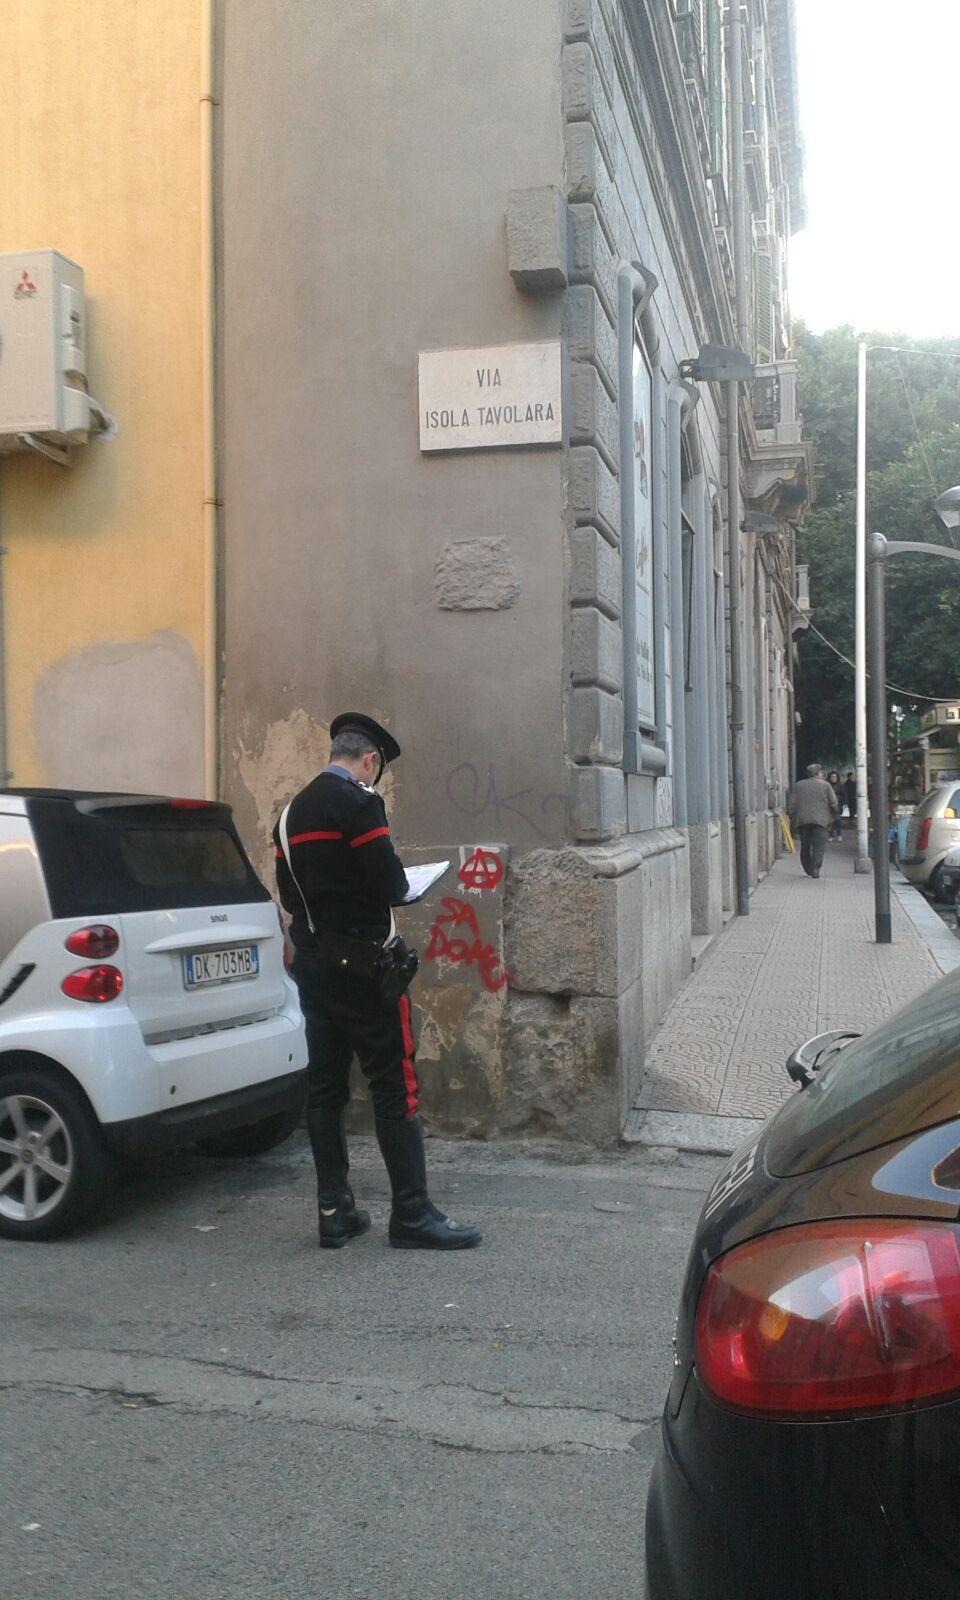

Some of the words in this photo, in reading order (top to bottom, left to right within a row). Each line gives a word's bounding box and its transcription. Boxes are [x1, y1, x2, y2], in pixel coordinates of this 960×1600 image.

[476, 368, 501, 387] VIA
[426, 408, 470, 429] ISOLA
[477, 402, 554, 426] TAVOLARA
[195, 955, 211, 980] DK
[215, 949, 252, 977] 703MB
